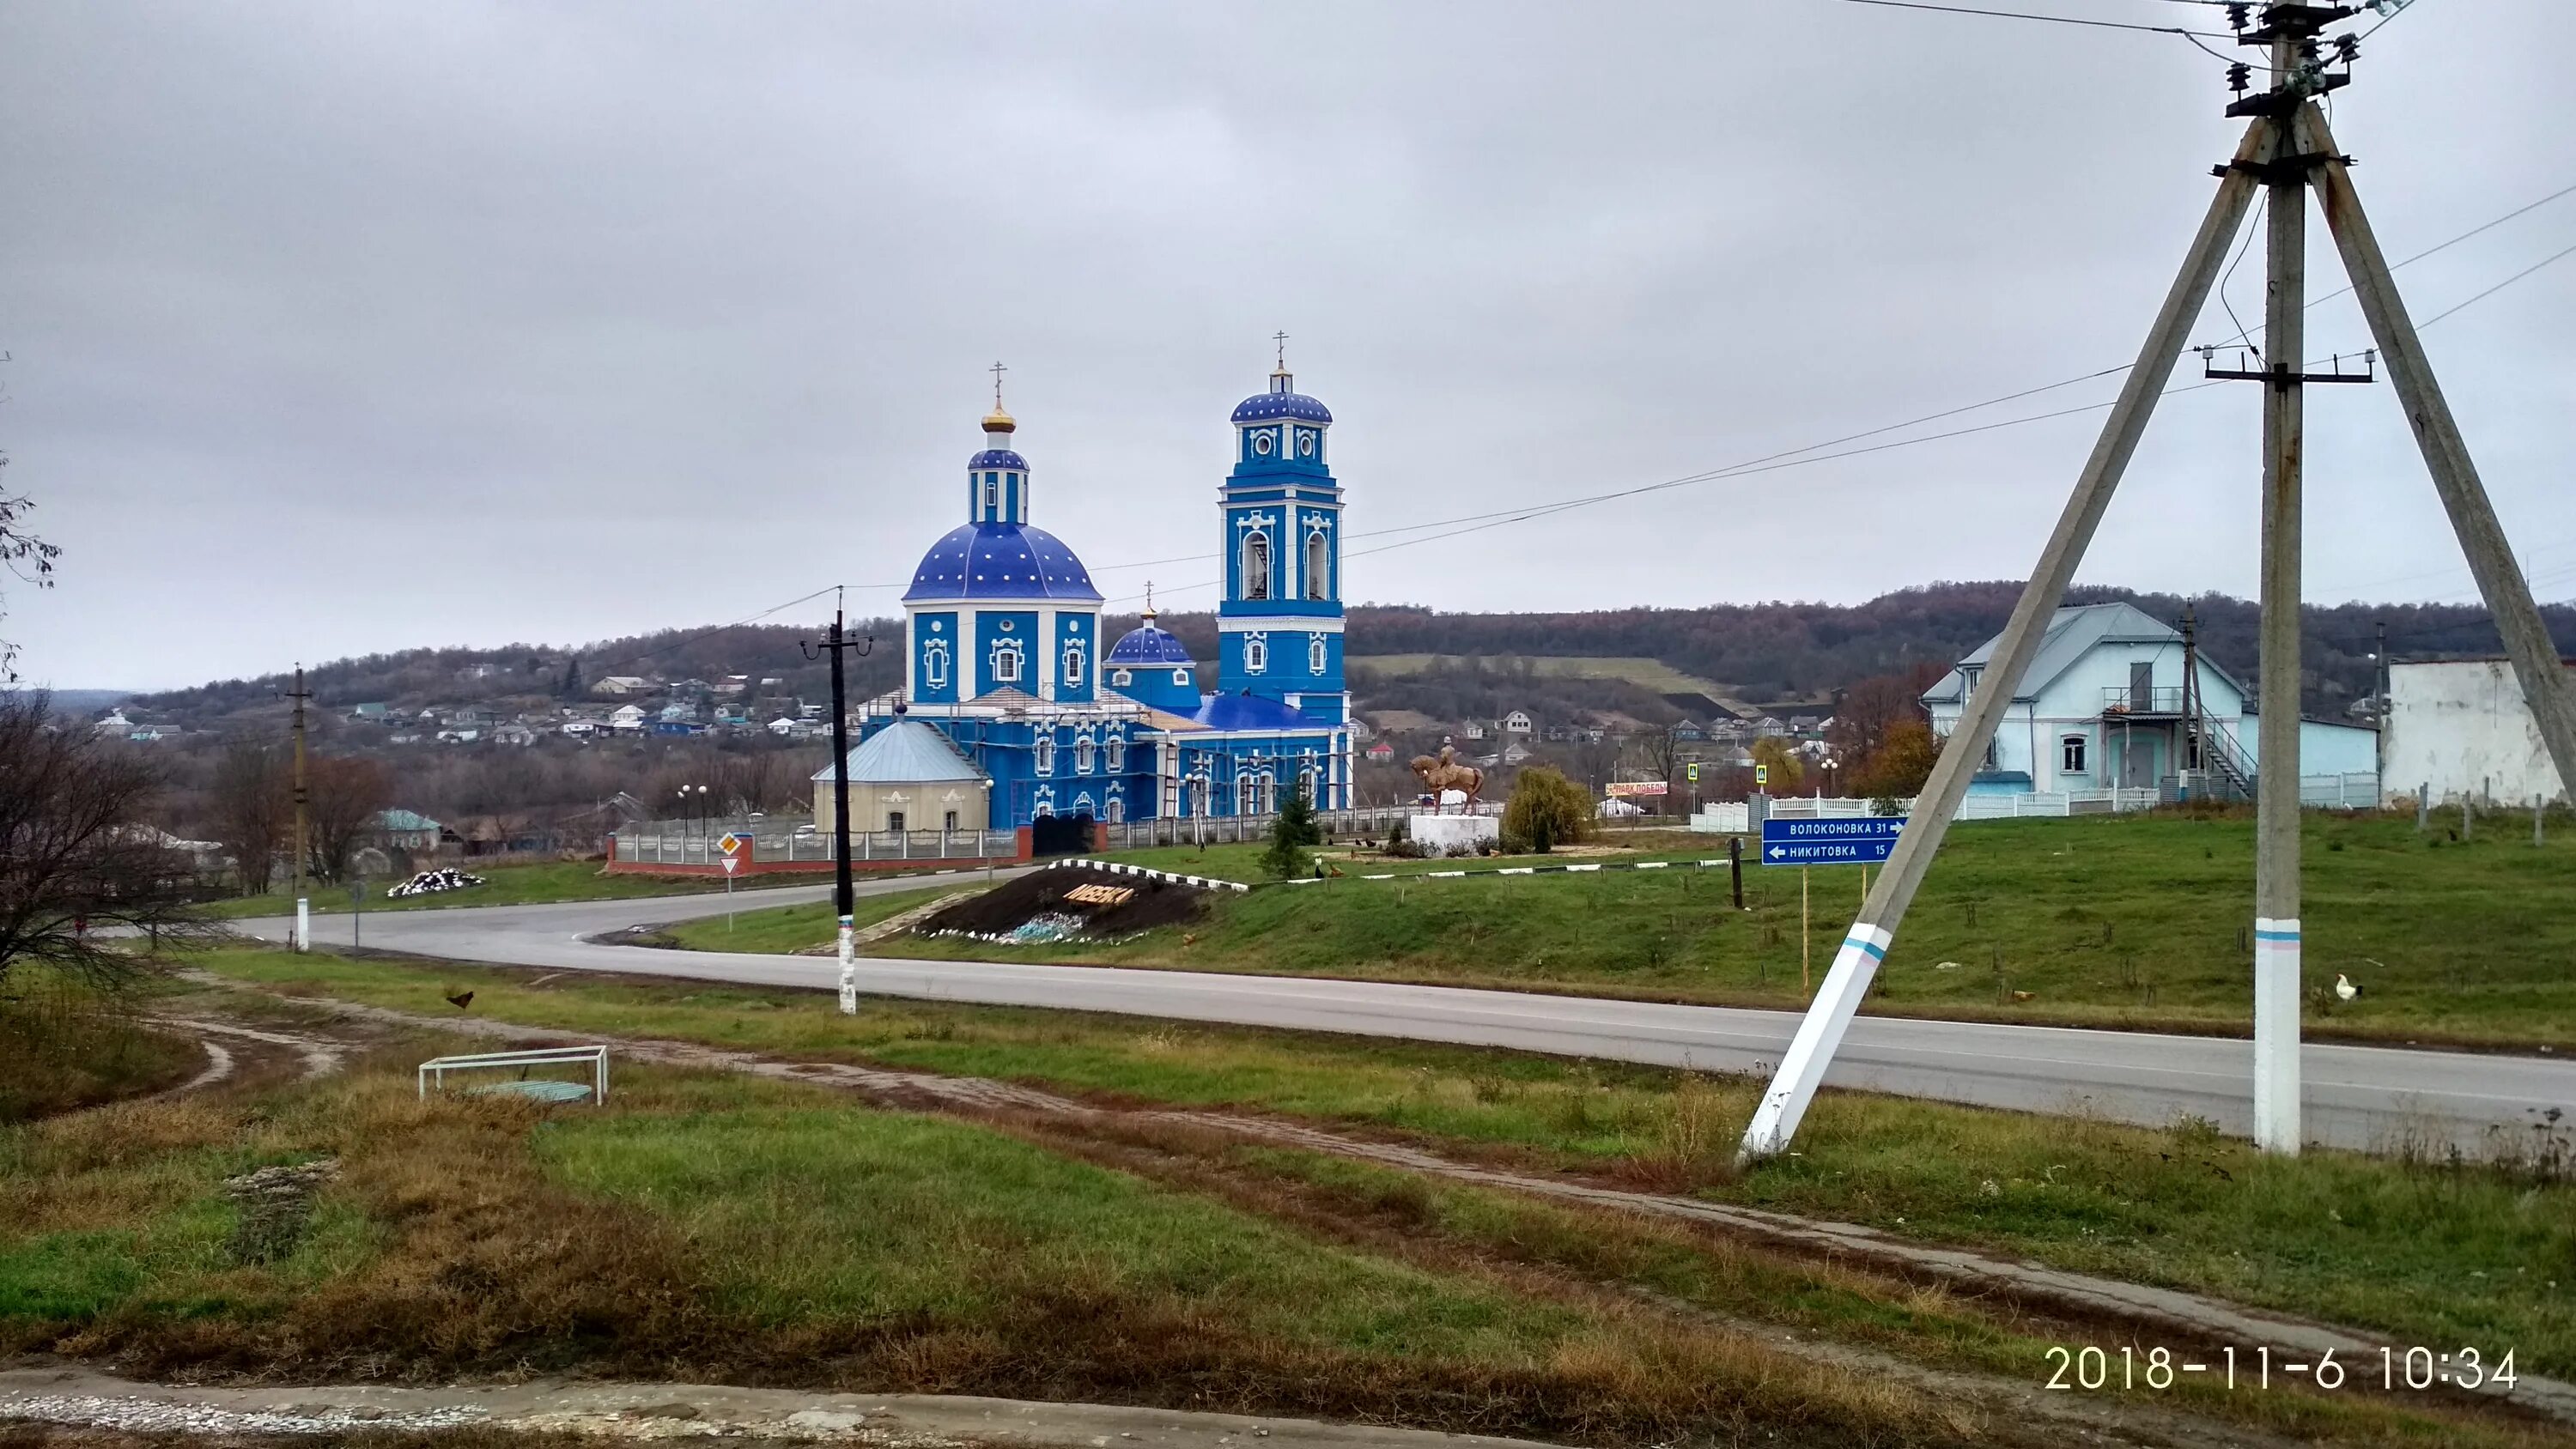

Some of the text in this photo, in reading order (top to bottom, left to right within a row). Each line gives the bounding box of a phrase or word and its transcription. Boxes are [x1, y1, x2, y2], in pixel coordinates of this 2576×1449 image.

[1616, 783, 1666, 793] ПАРК ПОБЕДЫ
[1790, 822, 1886, 835] ВОЛОКОНОВКА 31
[1789, 845, 1886, 858] НИКИТОВКА 15
